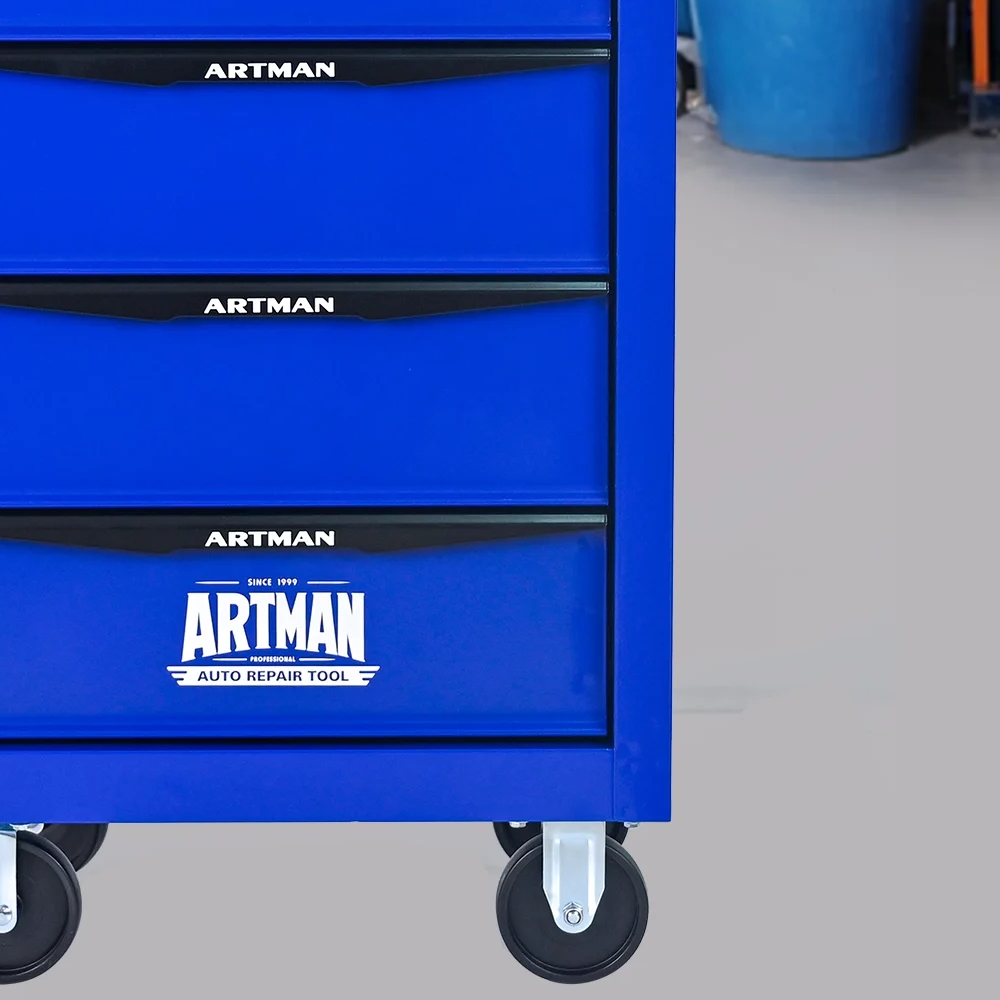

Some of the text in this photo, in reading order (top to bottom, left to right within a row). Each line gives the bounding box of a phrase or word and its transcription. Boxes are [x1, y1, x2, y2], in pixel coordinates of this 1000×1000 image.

[204, 62, 335, 79] ARTMAN
[204, 297, 335, 314] ARTMAN
[204, 531, 335, 547] ARTMAN
[247, 578, 298, 587] SINCE 1999
[181, 592, 366, 662] ARTMAN
[197, 670, 349, 682] AUTO REPAIR TOOL
